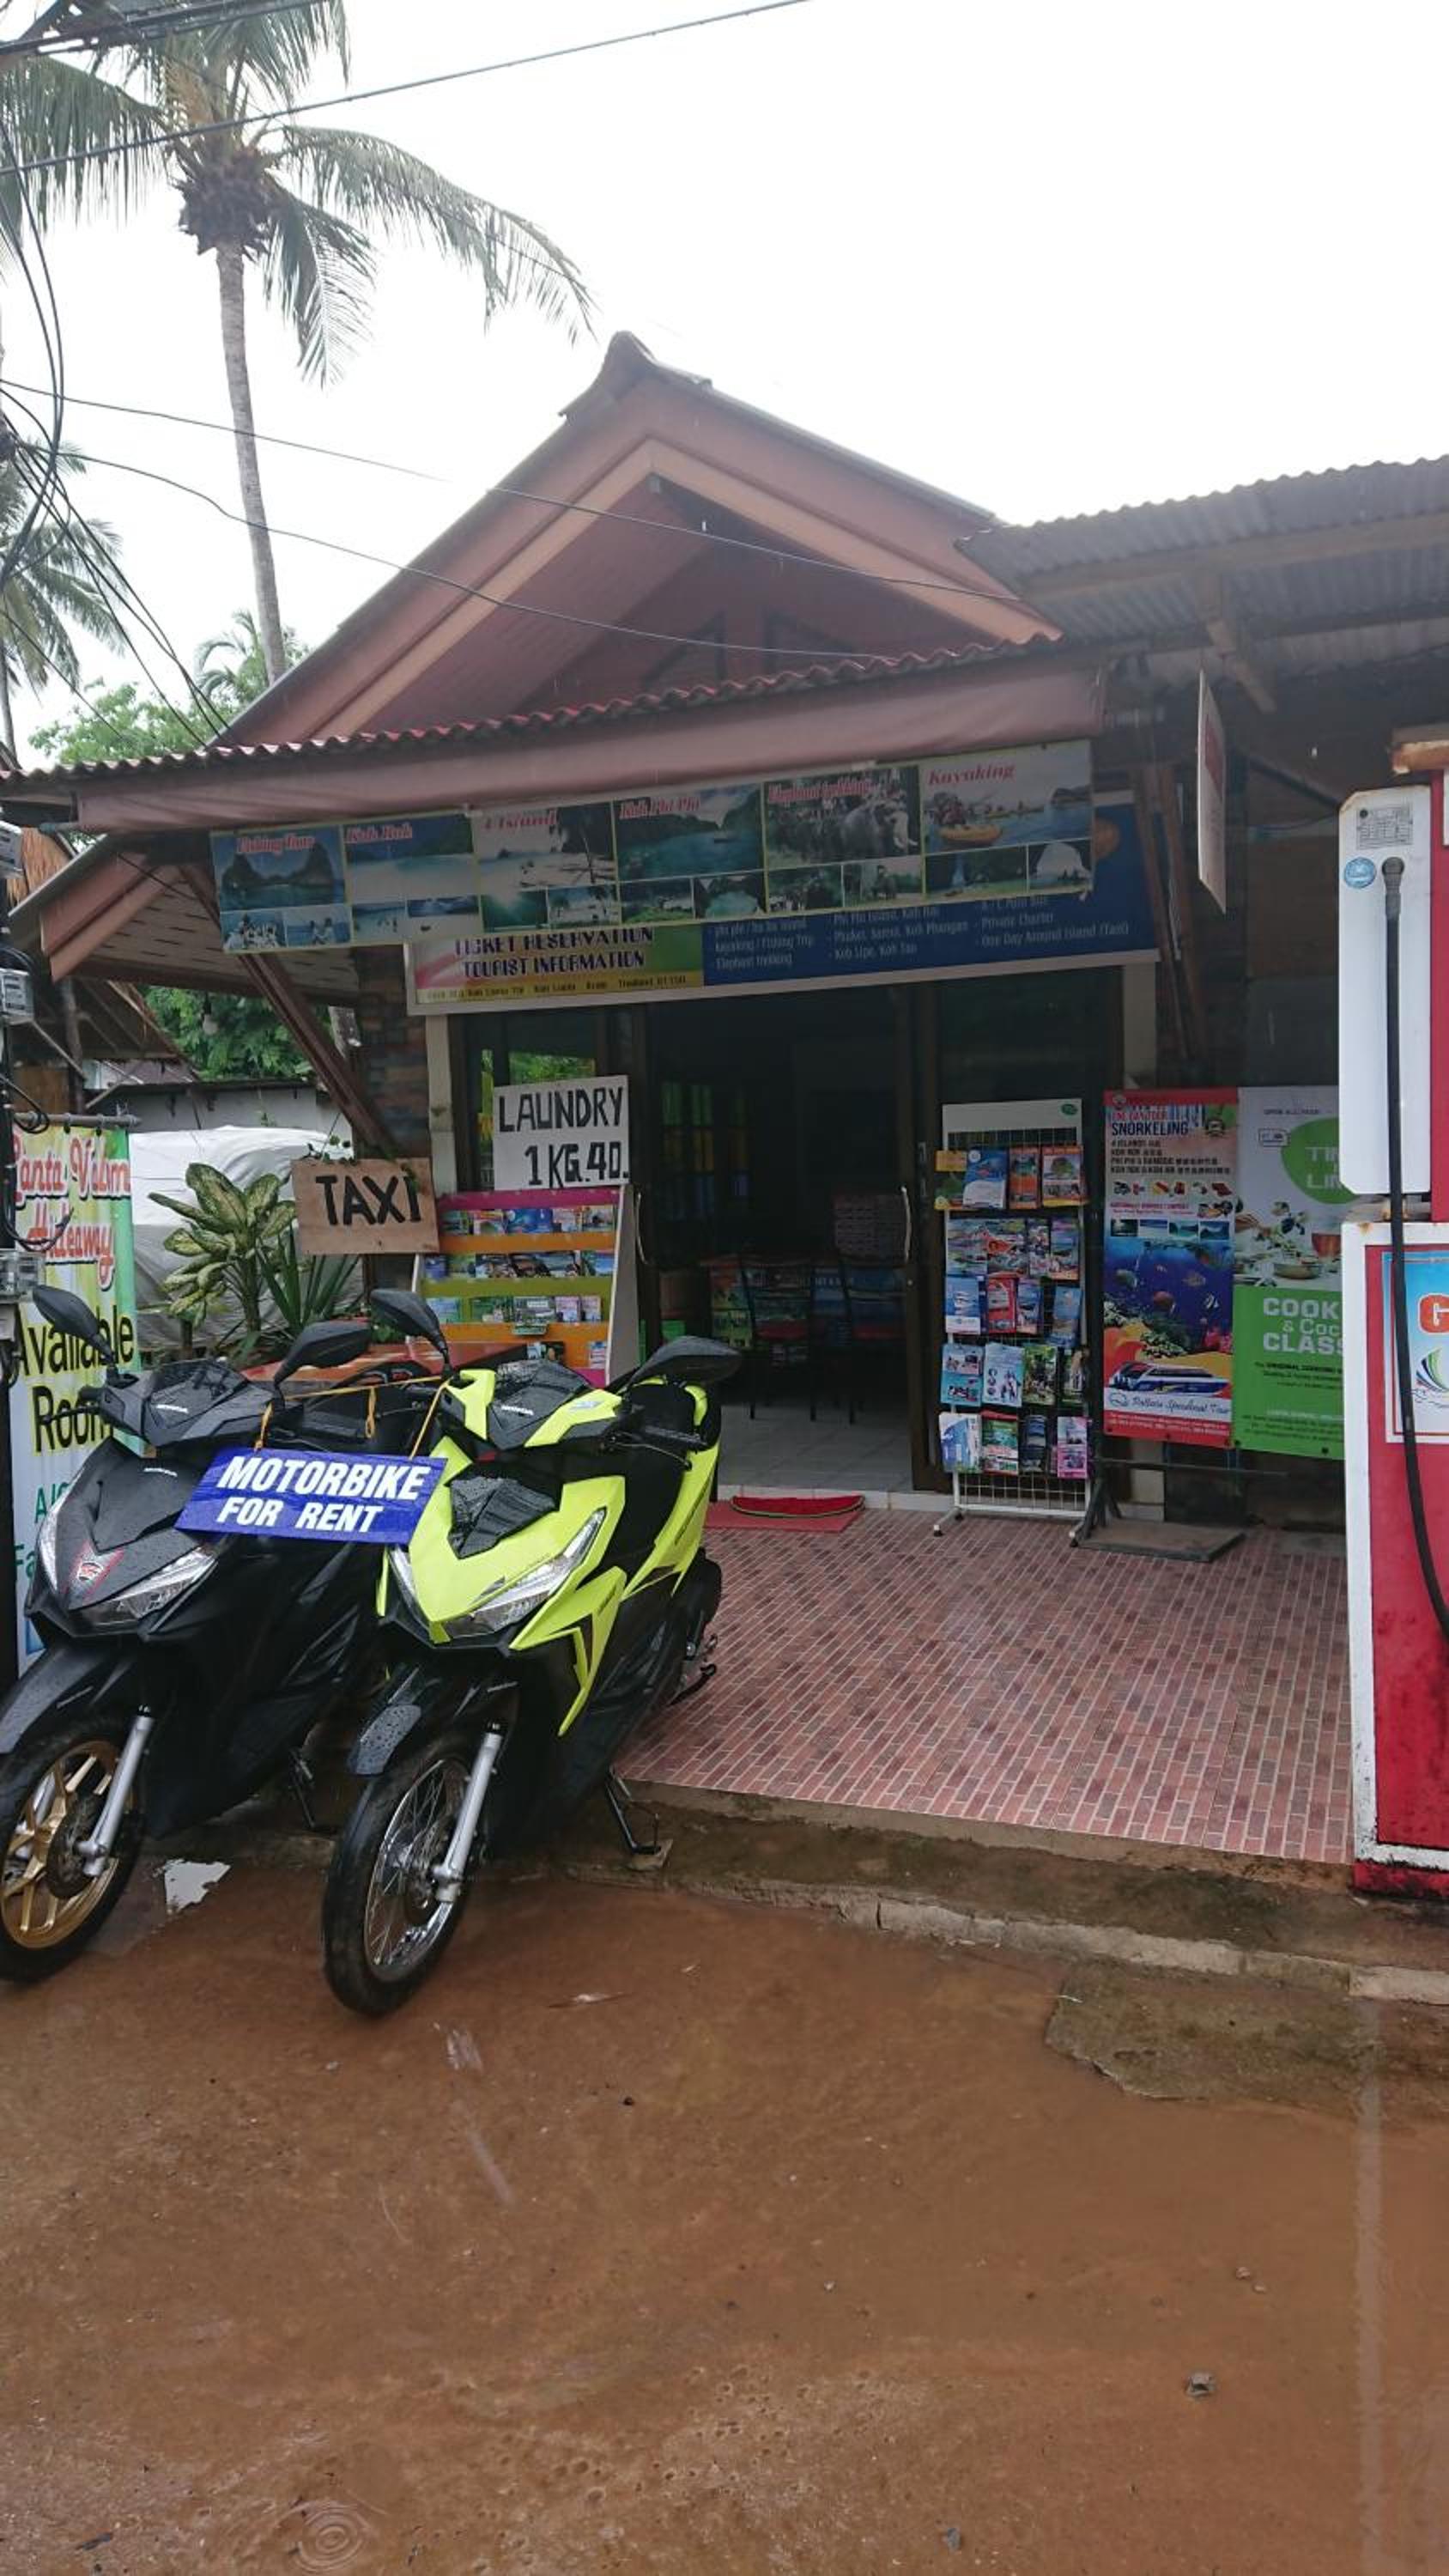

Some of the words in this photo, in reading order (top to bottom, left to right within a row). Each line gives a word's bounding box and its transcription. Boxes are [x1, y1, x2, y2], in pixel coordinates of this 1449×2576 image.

[929, 762, 1016, 786] Kayaking
[456, 933, 516, 956] TICKET
[524, 927, 654, 951] RESERVATION
[464, 957, 528, 979] TOURIST
[533, 950, 646, 973] INFORMATION
[499, 1086, 625, 1133] LAUNDRY
[1112, 1121, 1190, 1137] SNORKELING
[315, 1171, 422, 1226] TAXI
[216, 1456, 432, 1501] MOTORBIKE
[216, 1497, 285, 1527] FOR
[295, 1503, 384, 1533] RENT
